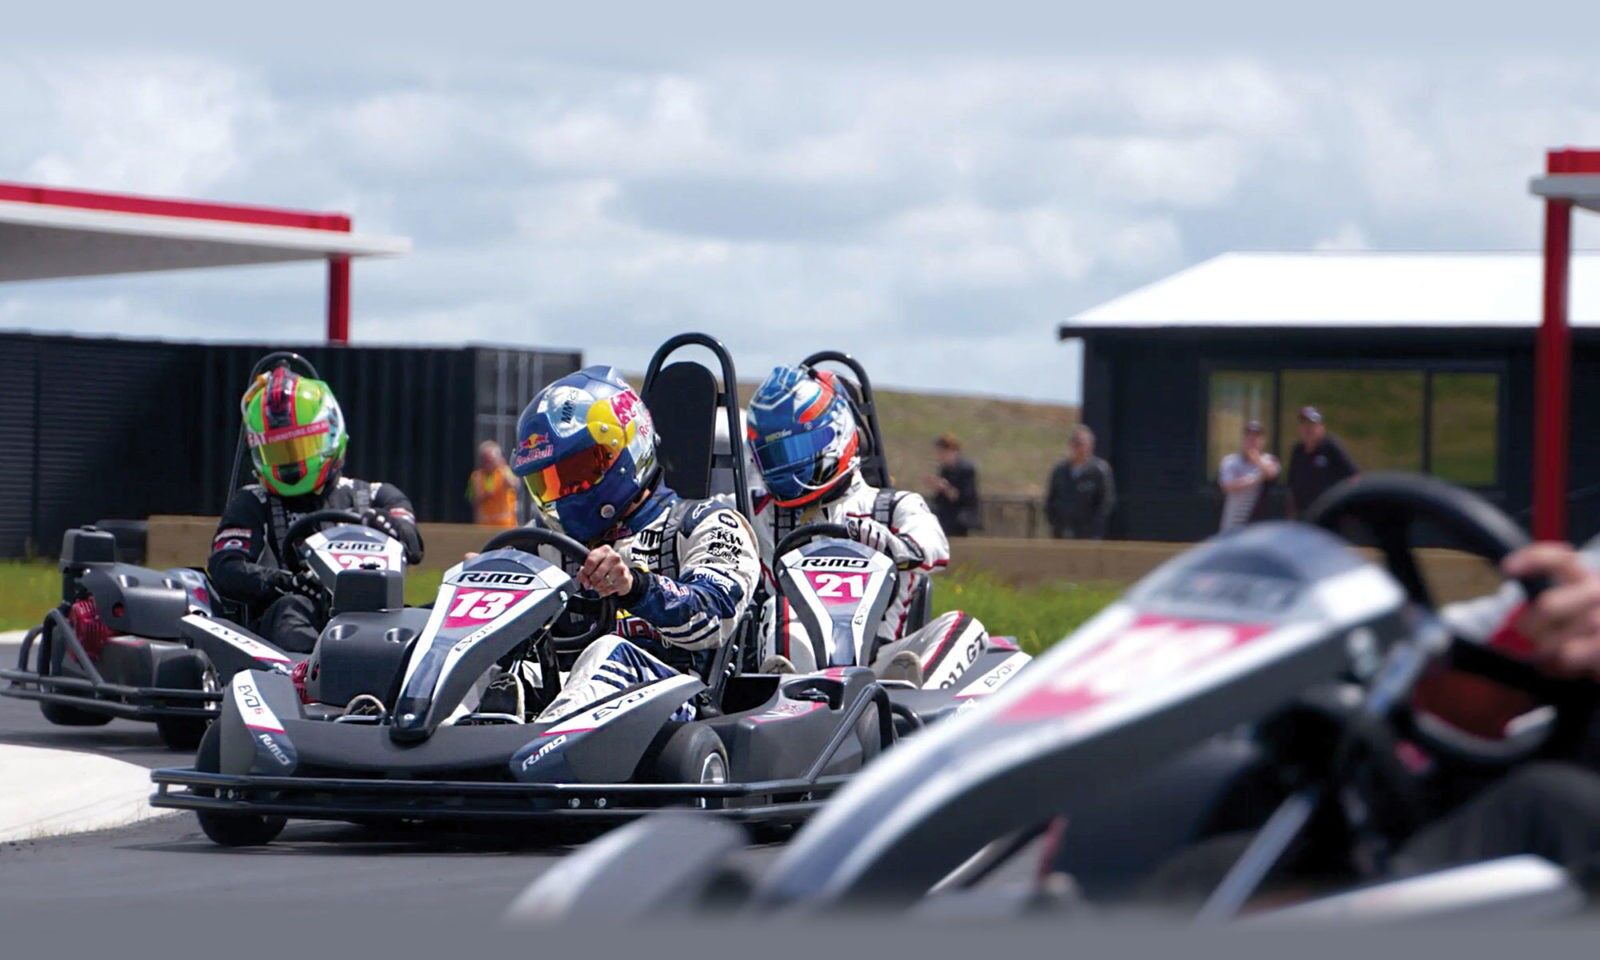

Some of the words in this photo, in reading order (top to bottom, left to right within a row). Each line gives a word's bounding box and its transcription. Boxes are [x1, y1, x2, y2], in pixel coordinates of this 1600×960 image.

[815, 573, 864, 598] 21
[449, 591, 516, 620] 13
[966, 631, 984, 665] GT
